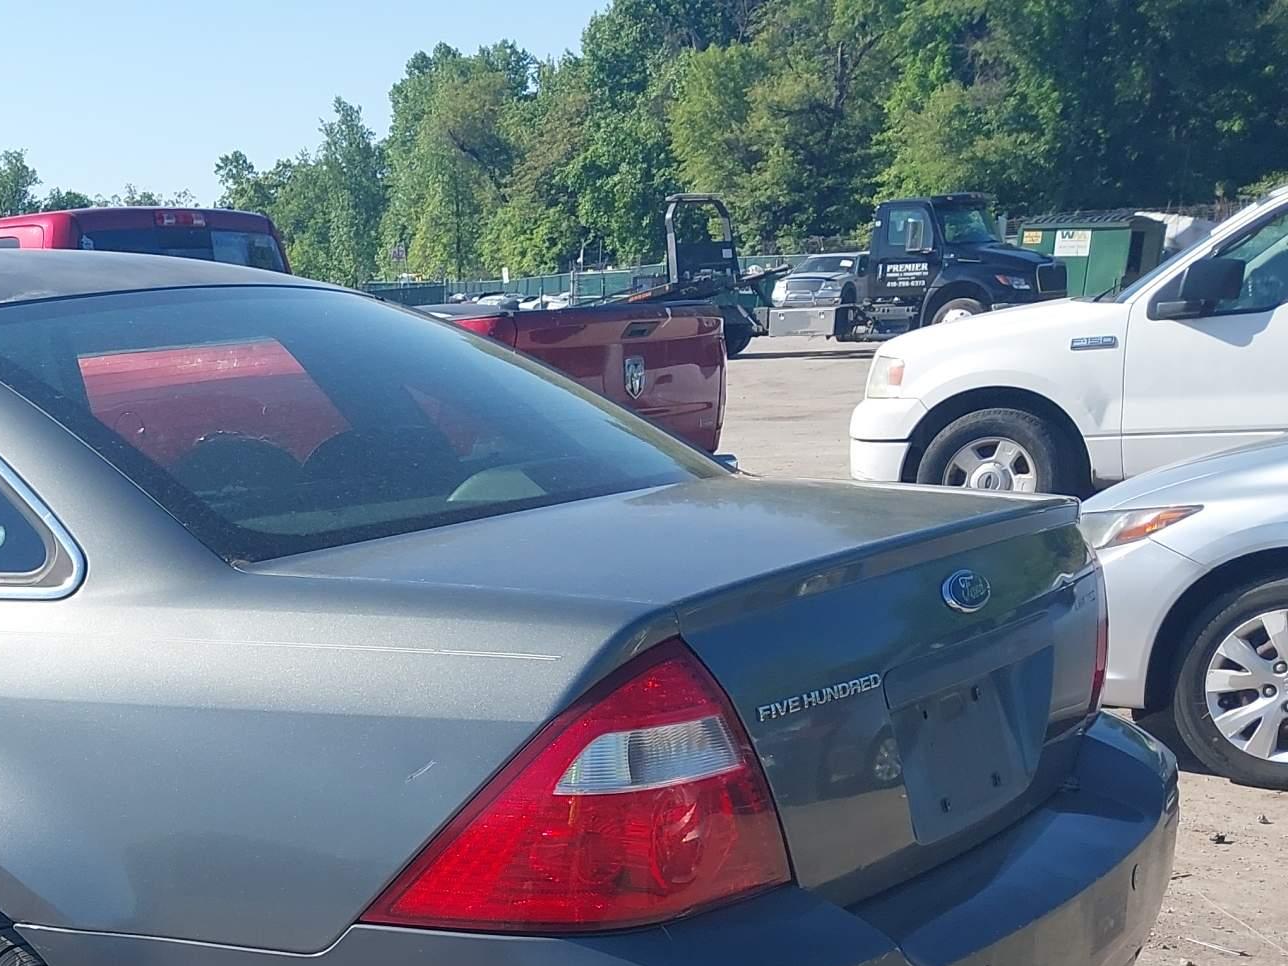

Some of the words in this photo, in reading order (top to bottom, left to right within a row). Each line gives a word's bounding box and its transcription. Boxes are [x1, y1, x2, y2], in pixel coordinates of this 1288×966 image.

[886, 262, 929, 273] PREMIER
[757, 696, 801, 722] FIVE
[802, 673, 882, 709] HUNDRED
